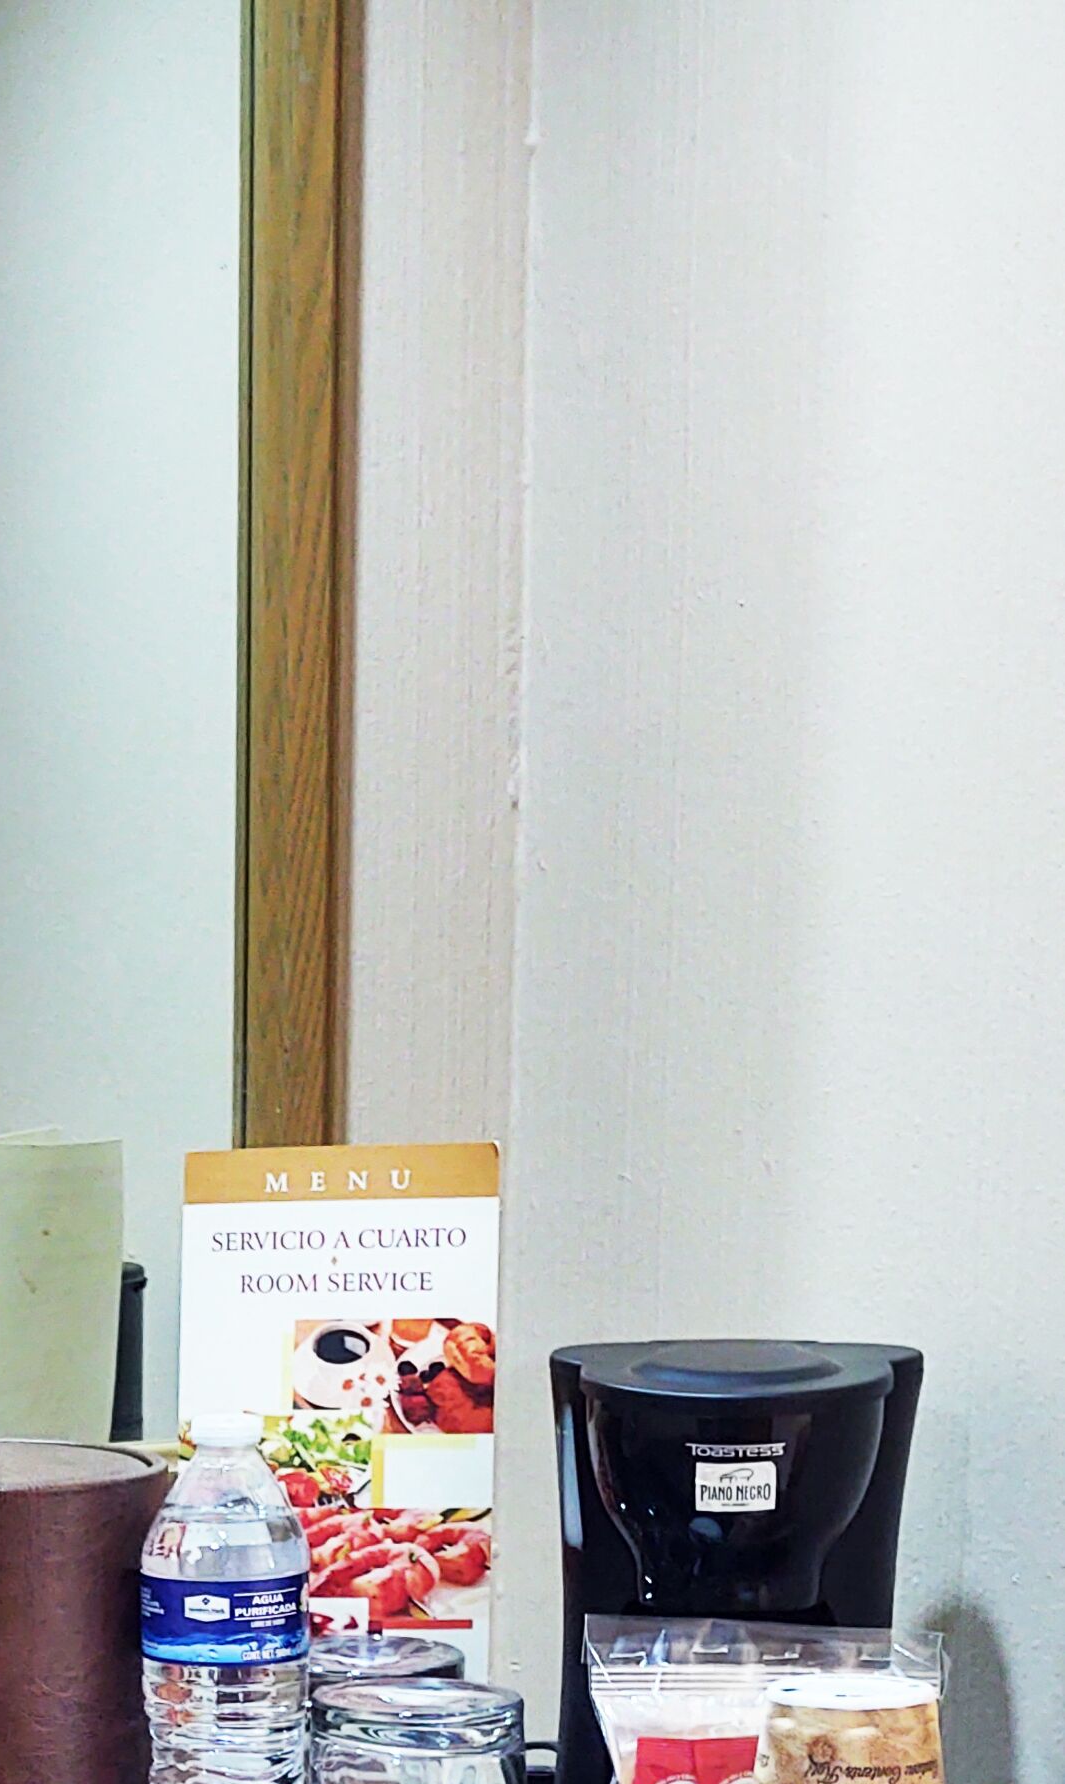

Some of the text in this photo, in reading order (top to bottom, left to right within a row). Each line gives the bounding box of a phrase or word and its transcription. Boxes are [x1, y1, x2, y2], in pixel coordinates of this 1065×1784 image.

[264, 1168, 412, 1194] MENU
[211, 1227, 468, 1253] SERVICIO A CUARTO
[240, 1271, 434, 1294] ROOM SERVICE
[700, 1482, 772, 1502] PIANO NEGRO
[234, 1602, 297, 1617] PURIFICADA
[252, 1593, 284, 1606] AGUA
